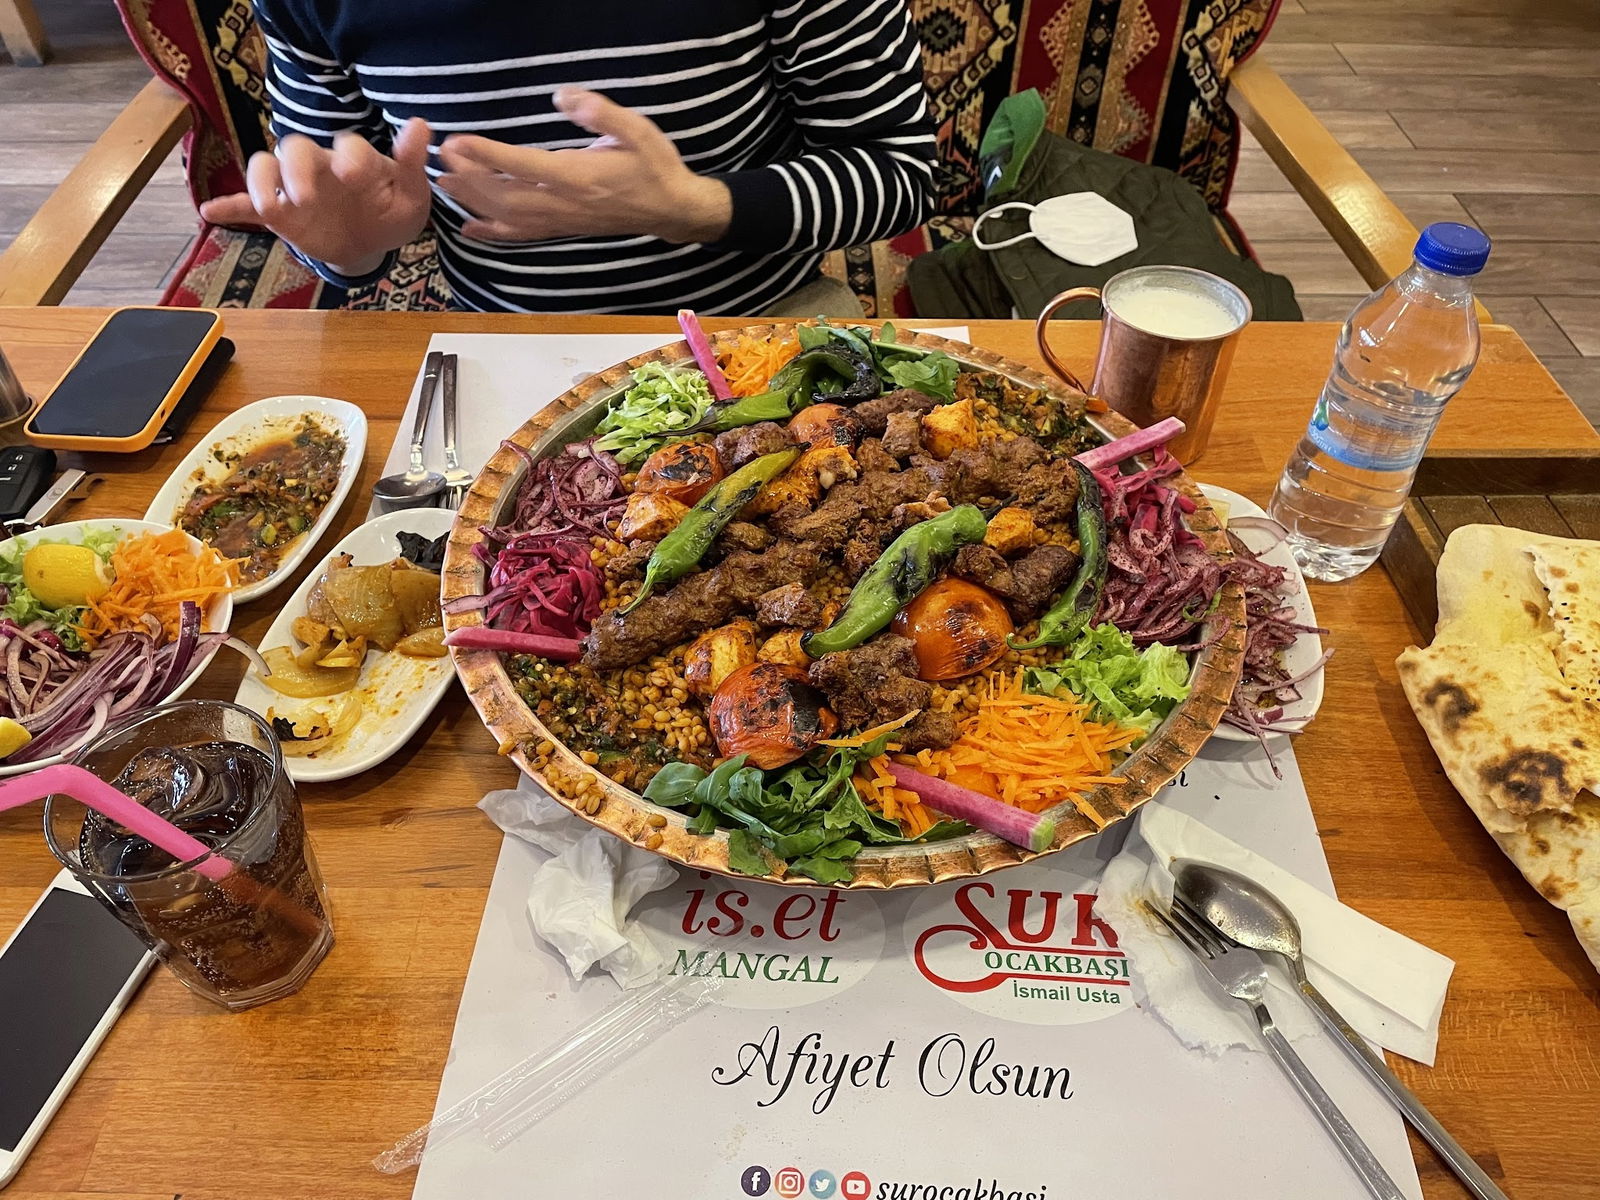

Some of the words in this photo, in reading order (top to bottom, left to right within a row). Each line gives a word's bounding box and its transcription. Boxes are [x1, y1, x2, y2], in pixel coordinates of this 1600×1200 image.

[668, 949, 839, 984] MANGAL
[984, 951, 1130, 979] OCAKBAŞI
[1013, 980, 1070, 1001] İsmail
[1077, 987, 1121, 1004] Usta
[711, 1025, 895, 1115] Afiyet
[918, 1032, 1075, 1101] Olsun
